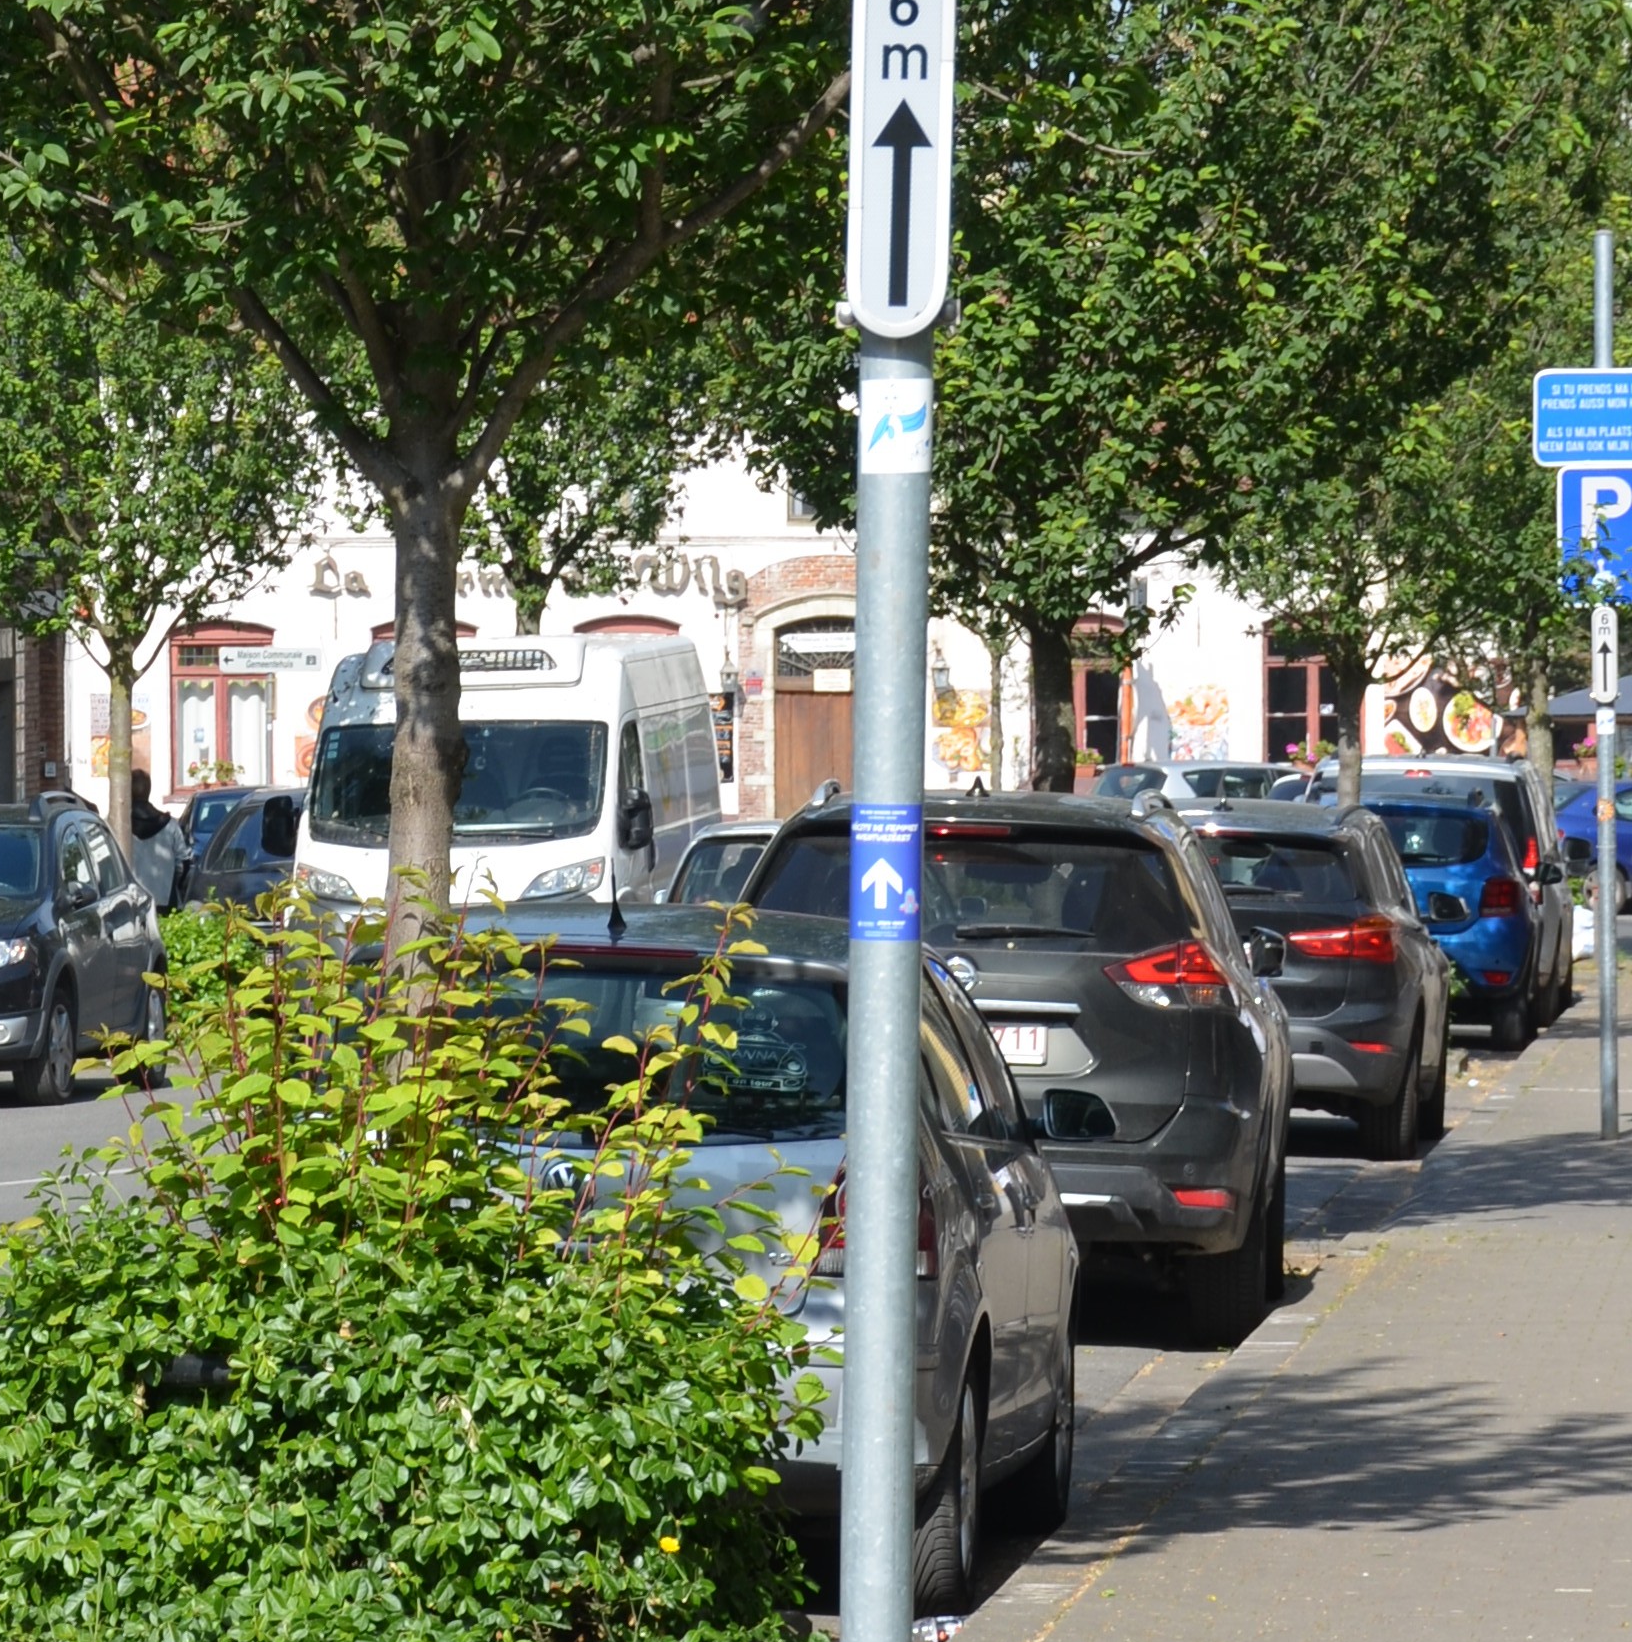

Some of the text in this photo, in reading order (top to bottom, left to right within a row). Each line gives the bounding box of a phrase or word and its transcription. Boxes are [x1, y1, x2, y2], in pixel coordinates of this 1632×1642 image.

[883, 43, 927, 80] m
[1601, 613, 1609, 625] 6
[1598, 625, 1611, 636] m
[237, 650, 303, 659] Maison Communale
[245, 659, 294, 669] Gemeentehuis
[732, 1049, 778, 1062] ANNA
